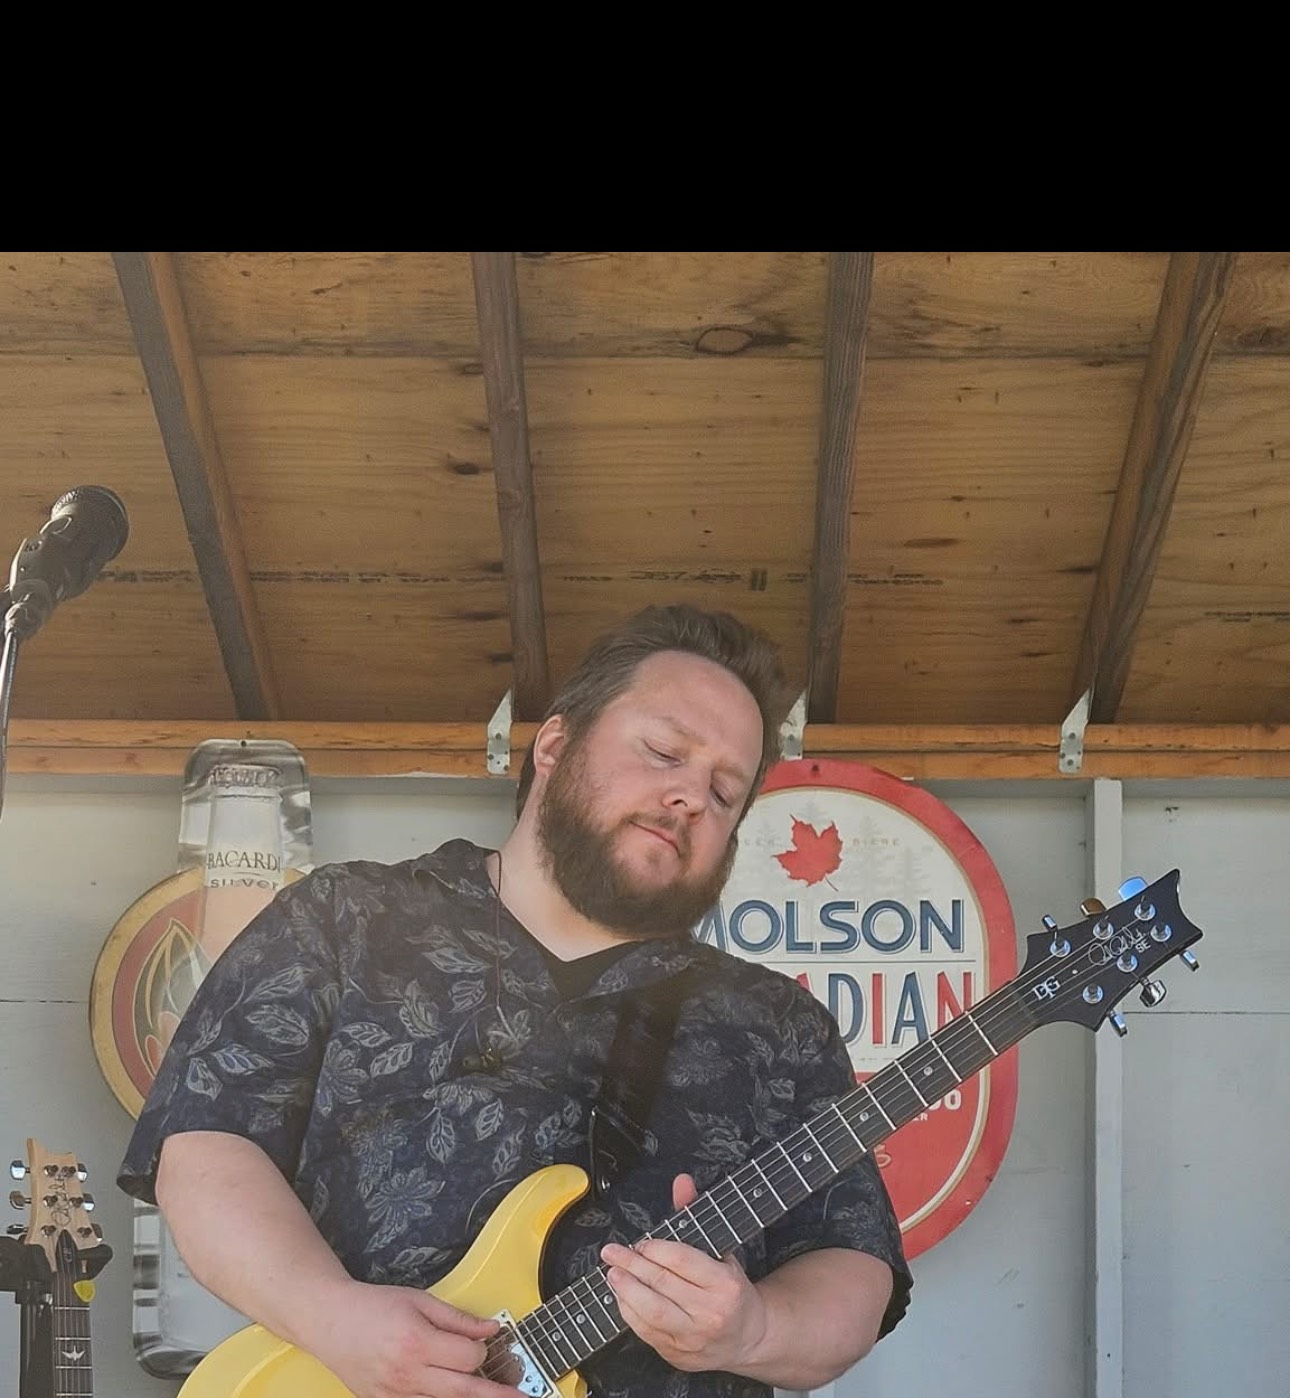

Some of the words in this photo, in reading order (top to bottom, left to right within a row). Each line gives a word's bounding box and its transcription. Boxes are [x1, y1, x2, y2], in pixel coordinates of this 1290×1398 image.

[206, 850, 281, 873] BACARDI
[1134, 939, 1152, 954] SE
[796, 970, 976, 1048] DIAN
